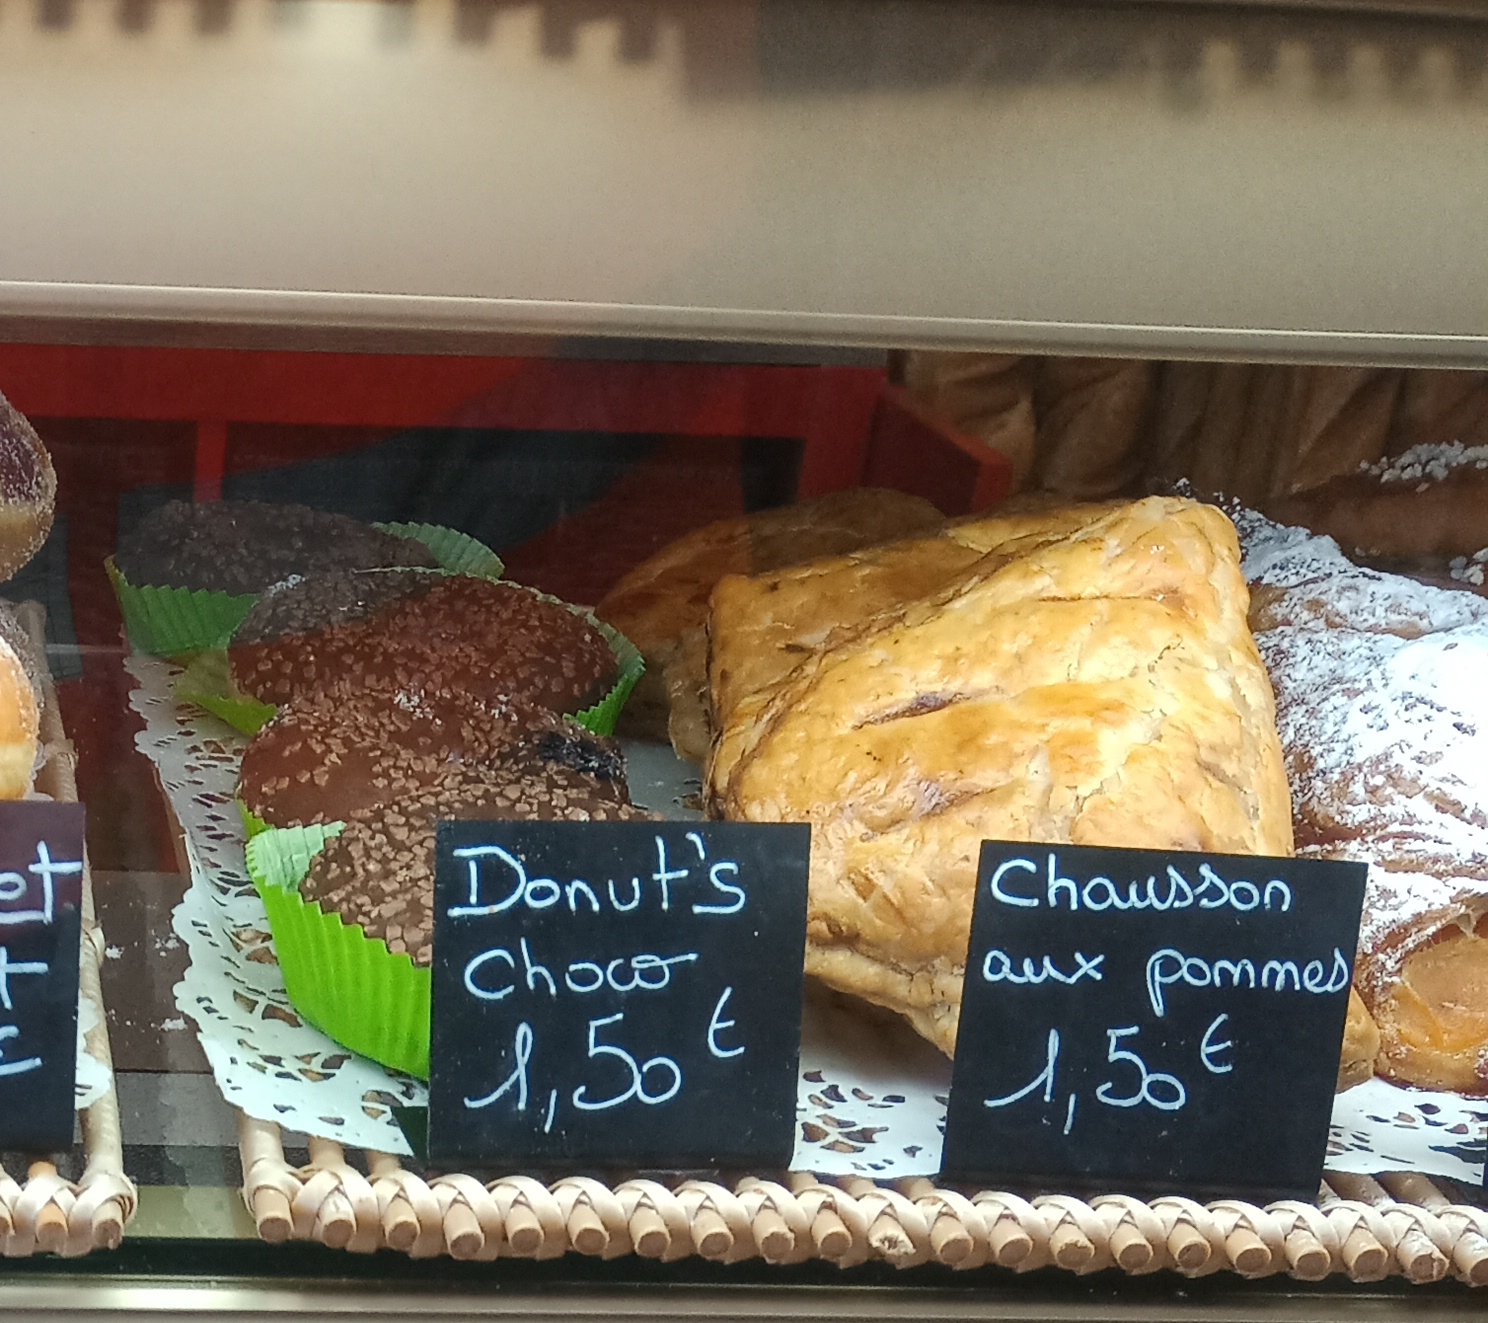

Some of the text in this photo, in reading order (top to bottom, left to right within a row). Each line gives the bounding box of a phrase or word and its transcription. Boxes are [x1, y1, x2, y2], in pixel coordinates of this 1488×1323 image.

[447, 832, 746, 918] Donut's
[990, 853, 1292, 912] Chausson
[463, 937, 699, 1000] Choco
[982, 948, 1350, 1017] aux pommes
